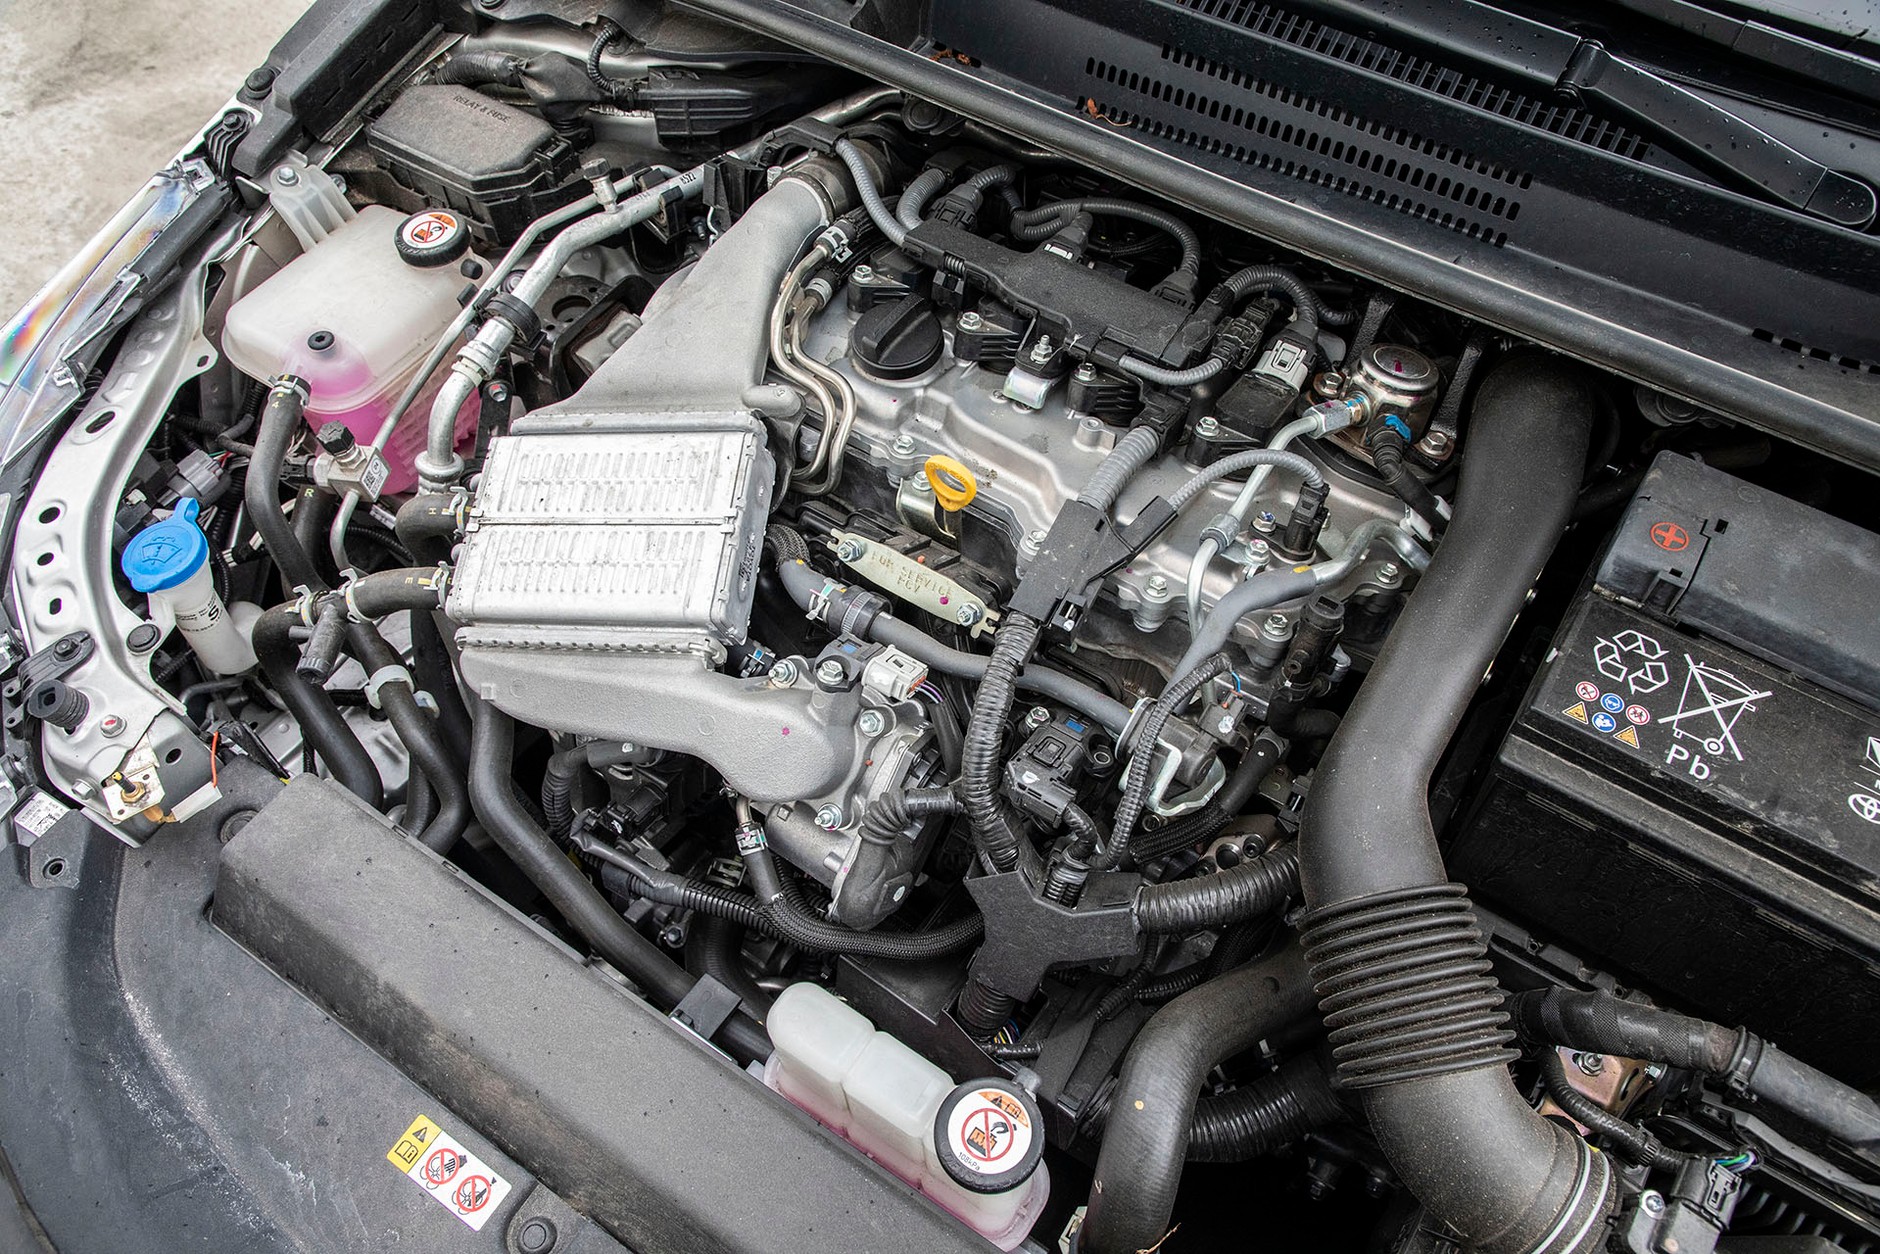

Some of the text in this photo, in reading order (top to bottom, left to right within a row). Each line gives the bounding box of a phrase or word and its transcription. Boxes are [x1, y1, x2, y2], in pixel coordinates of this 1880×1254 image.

[453, 95, 480, 110] RELAY
[487, 109, 511, 123] FUSE
[304, 488, 315, 498] R
[899, 566, 952, 598] SERVICE
[208, 604, 219, 621] S
[1665, 743, 1710, 780] Pb
